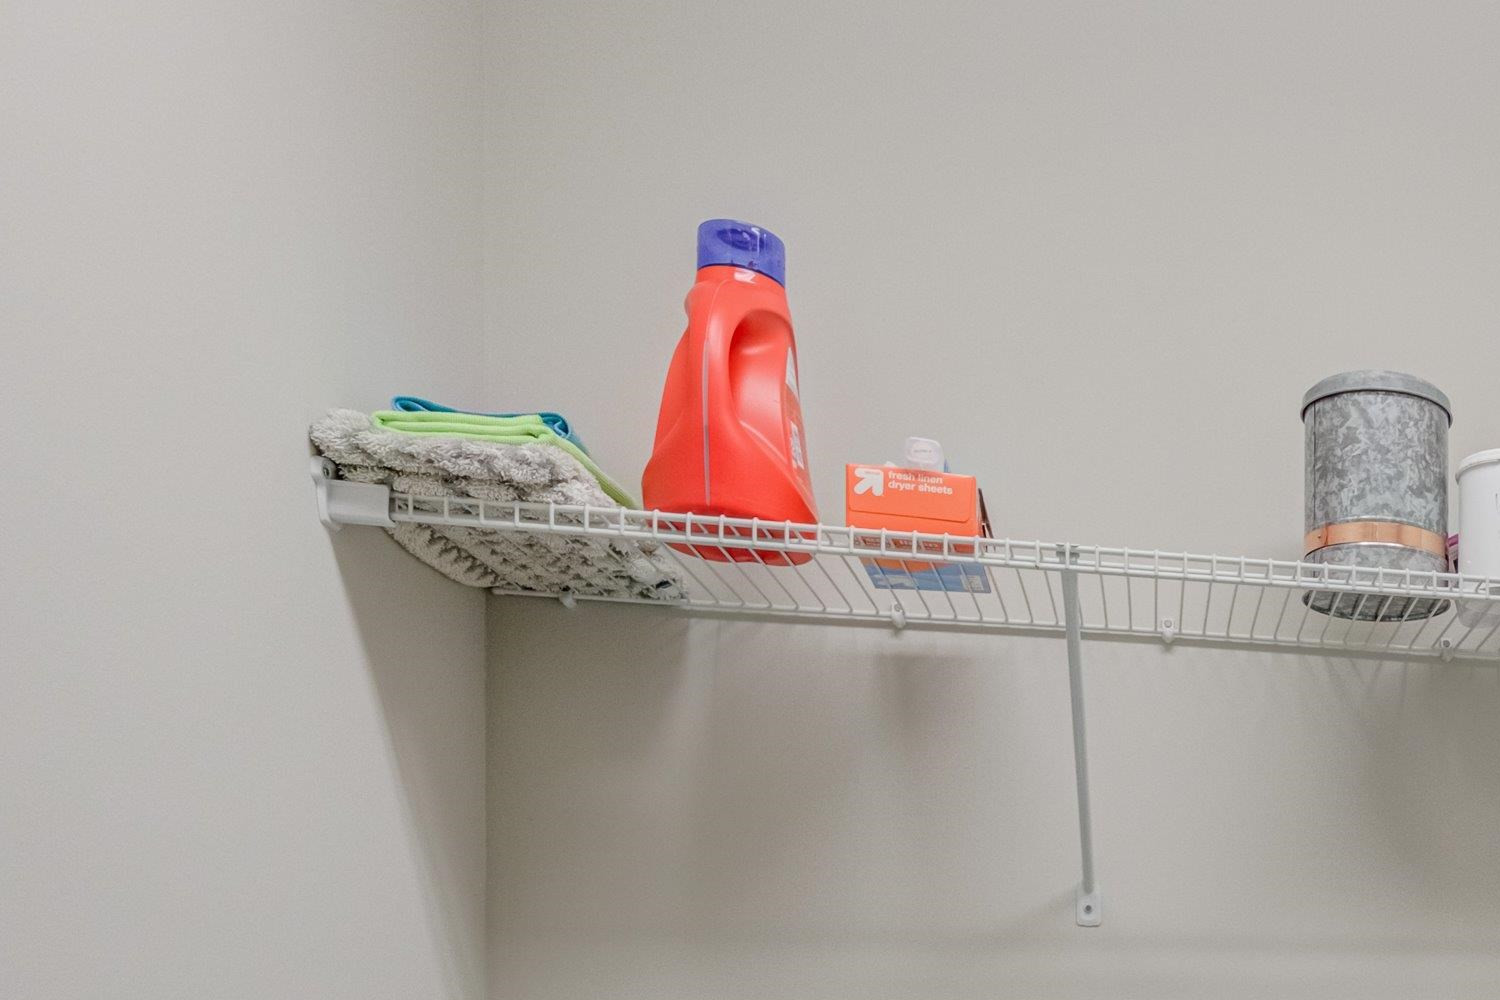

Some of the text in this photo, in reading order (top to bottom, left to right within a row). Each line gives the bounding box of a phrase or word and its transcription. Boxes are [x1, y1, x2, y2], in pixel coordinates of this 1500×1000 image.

[888, 471, 944, 484] fresh linen
[888, 480, 953, 495] dryer sheets
